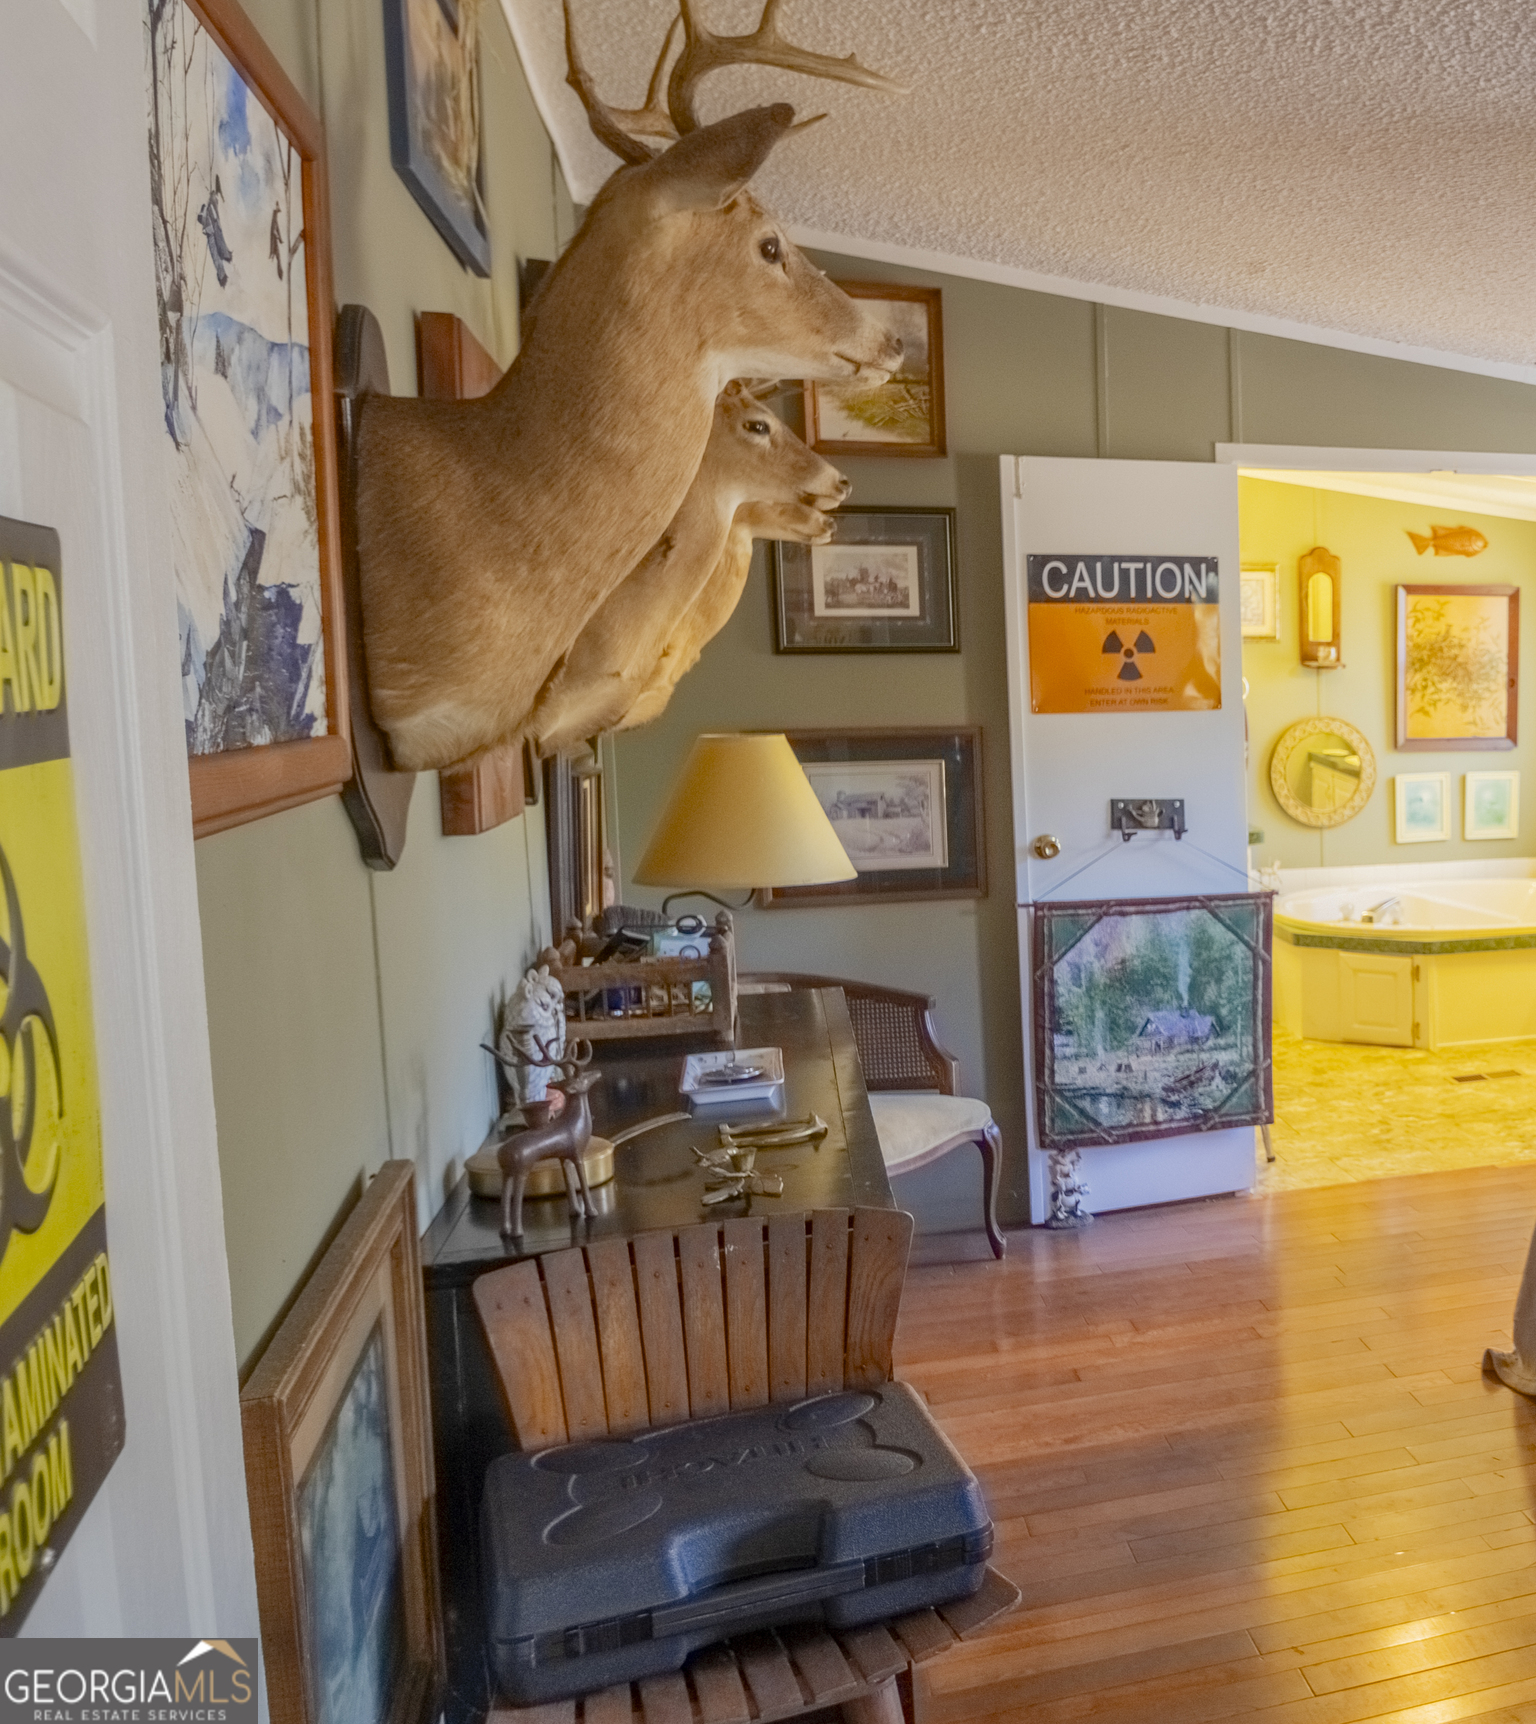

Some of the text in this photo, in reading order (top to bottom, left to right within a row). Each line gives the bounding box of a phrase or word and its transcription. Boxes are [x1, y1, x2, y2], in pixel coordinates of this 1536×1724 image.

[1042, 560, 1207, 598] CAUTION
[1074, 607, 1178, 615] HAZARDOUS RADIOACTIVE
[1105, 617, 1150, 626] MATERIALS
[1084, 686, 1175, 696] HANDLED IN THIS AREA
[1090, 699, 1117, 707] ENTER
[1130, 698, 1148, 706] OWN
[0, 1251, 113, 1490] AMINATED
[0, 1418, 73, 1618] ROOM
